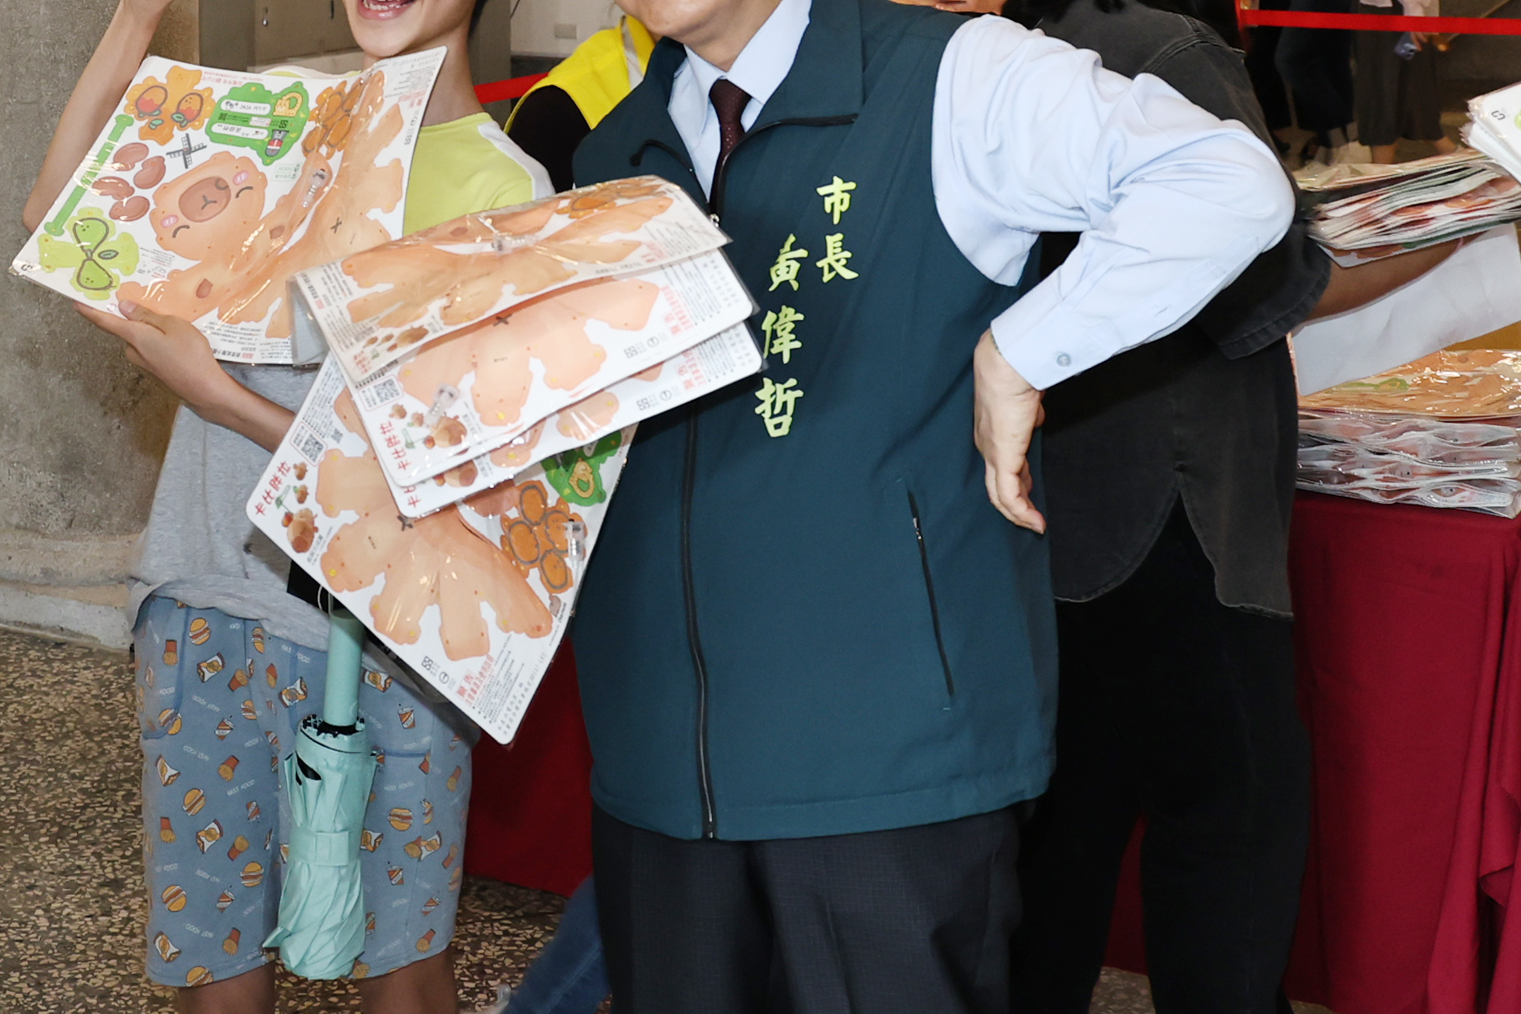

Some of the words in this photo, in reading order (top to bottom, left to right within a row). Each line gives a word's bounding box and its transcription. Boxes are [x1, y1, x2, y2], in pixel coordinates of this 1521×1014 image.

[815, 175, 860, 284] 市長
[754, 233, 809, 438] 黃偉哲
